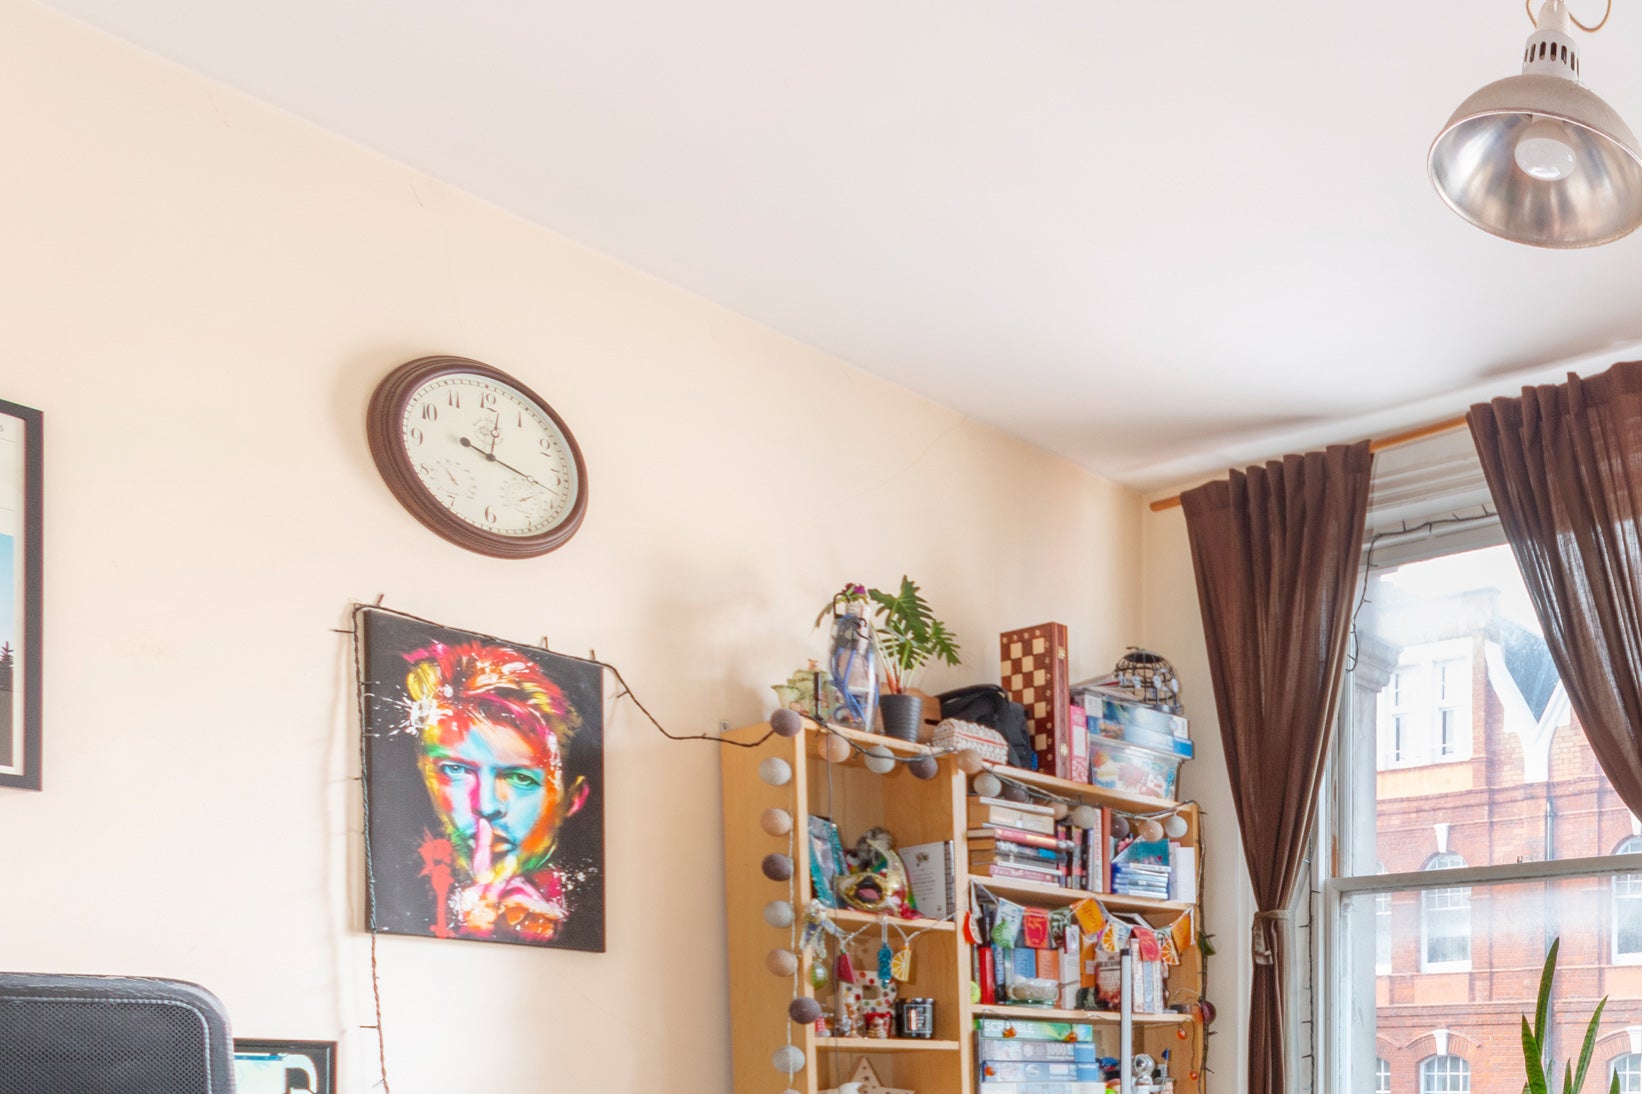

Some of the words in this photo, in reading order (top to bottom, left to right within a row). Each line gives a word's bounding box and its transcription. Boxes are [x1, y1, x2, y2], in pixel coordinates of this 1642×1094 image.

[448, 389, 461, 409] 11
[421, 401, 438, 422] 10
[410, 427, 423, 446] 9
[539, 438, 552, 458] 2
[484, 505, 497, 525] 6
